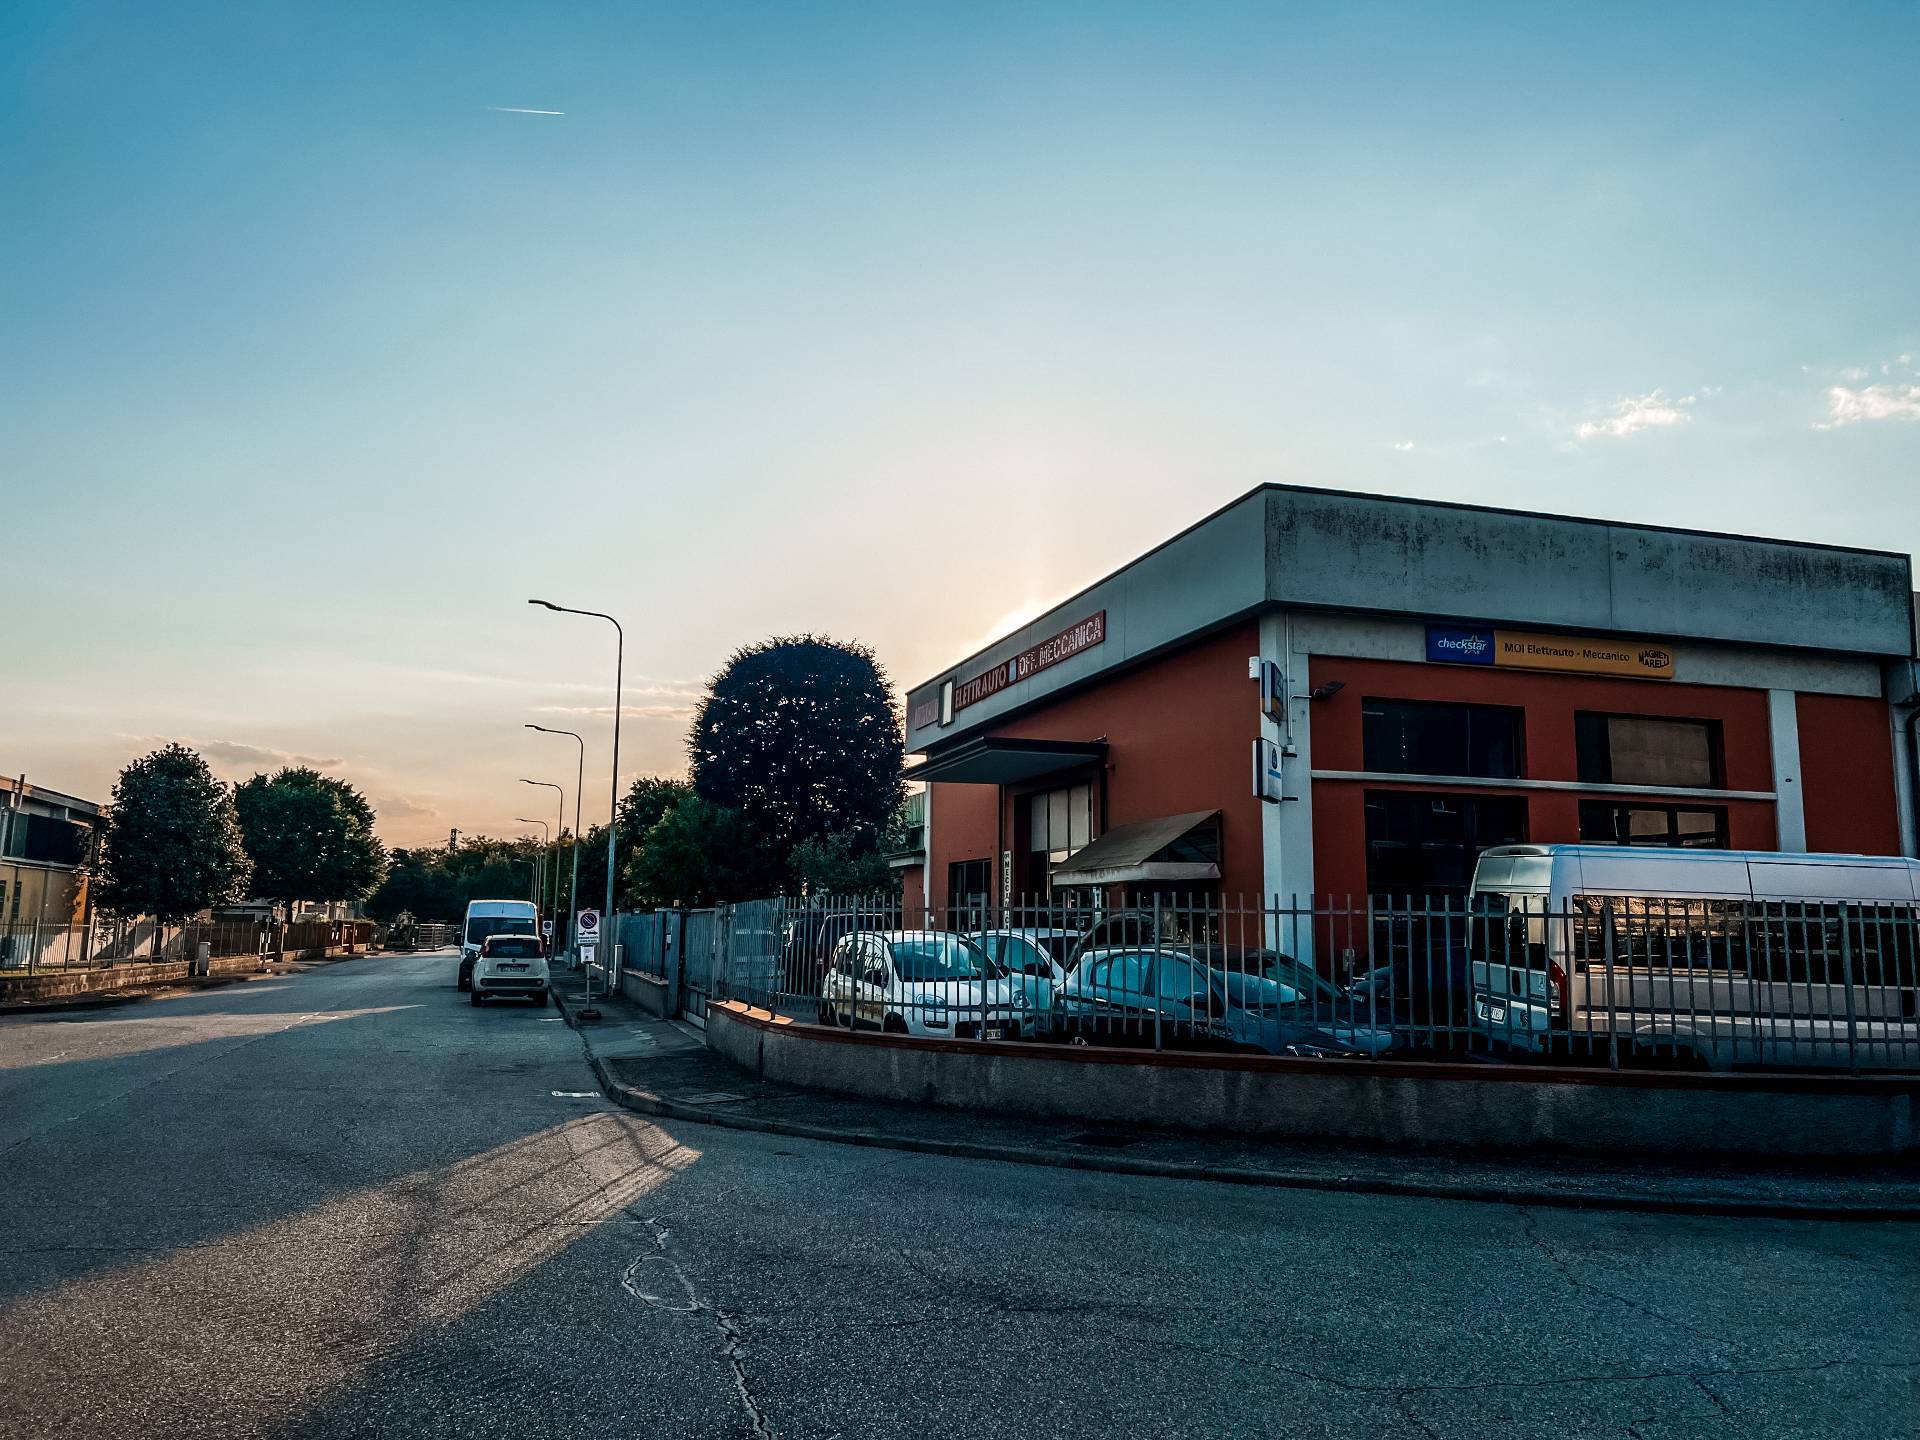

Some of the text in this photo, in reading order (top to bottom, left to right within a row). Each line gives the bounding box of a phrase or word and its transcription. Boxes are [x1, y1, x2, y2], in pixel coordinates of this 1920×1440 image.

[1438, 637, 1487, 651] checkstar
[1504, 643, 1524, 654] MOI
[1527, 645, 1574, 657] Elettrauto
[1583, 649, 1630, 662] Meccanico
[955, 617, 1102, 709] ELETTRAUTO OFF. MECCANICA
